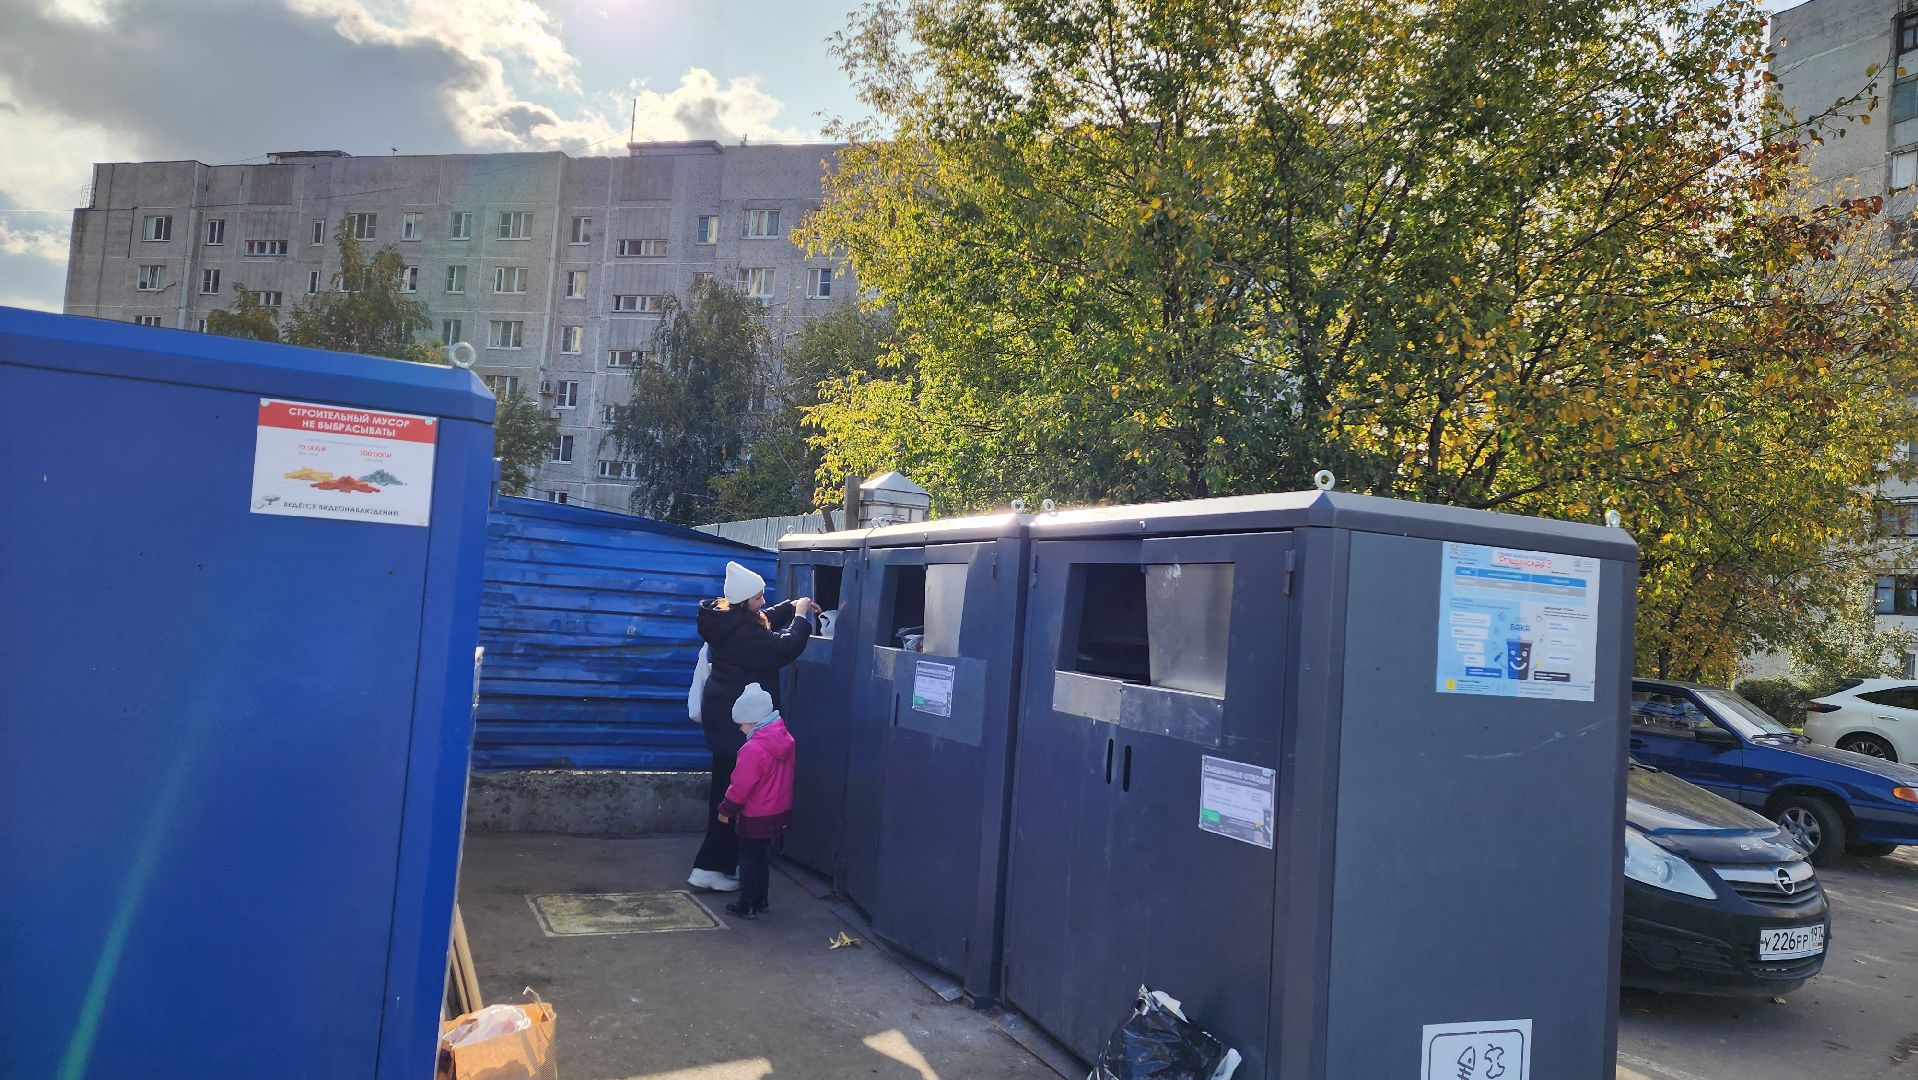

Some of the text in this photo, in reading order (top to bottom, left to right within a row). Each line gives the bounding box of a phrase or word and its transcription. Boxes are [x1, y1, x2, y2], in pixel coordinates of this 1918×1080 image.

[288, 407, 410, 428] СТРОИТЕЛЬНЫЙ МУСОР
[302, 419, 396, 437] НЕ ВЫБРАСЫВАТЬ!
